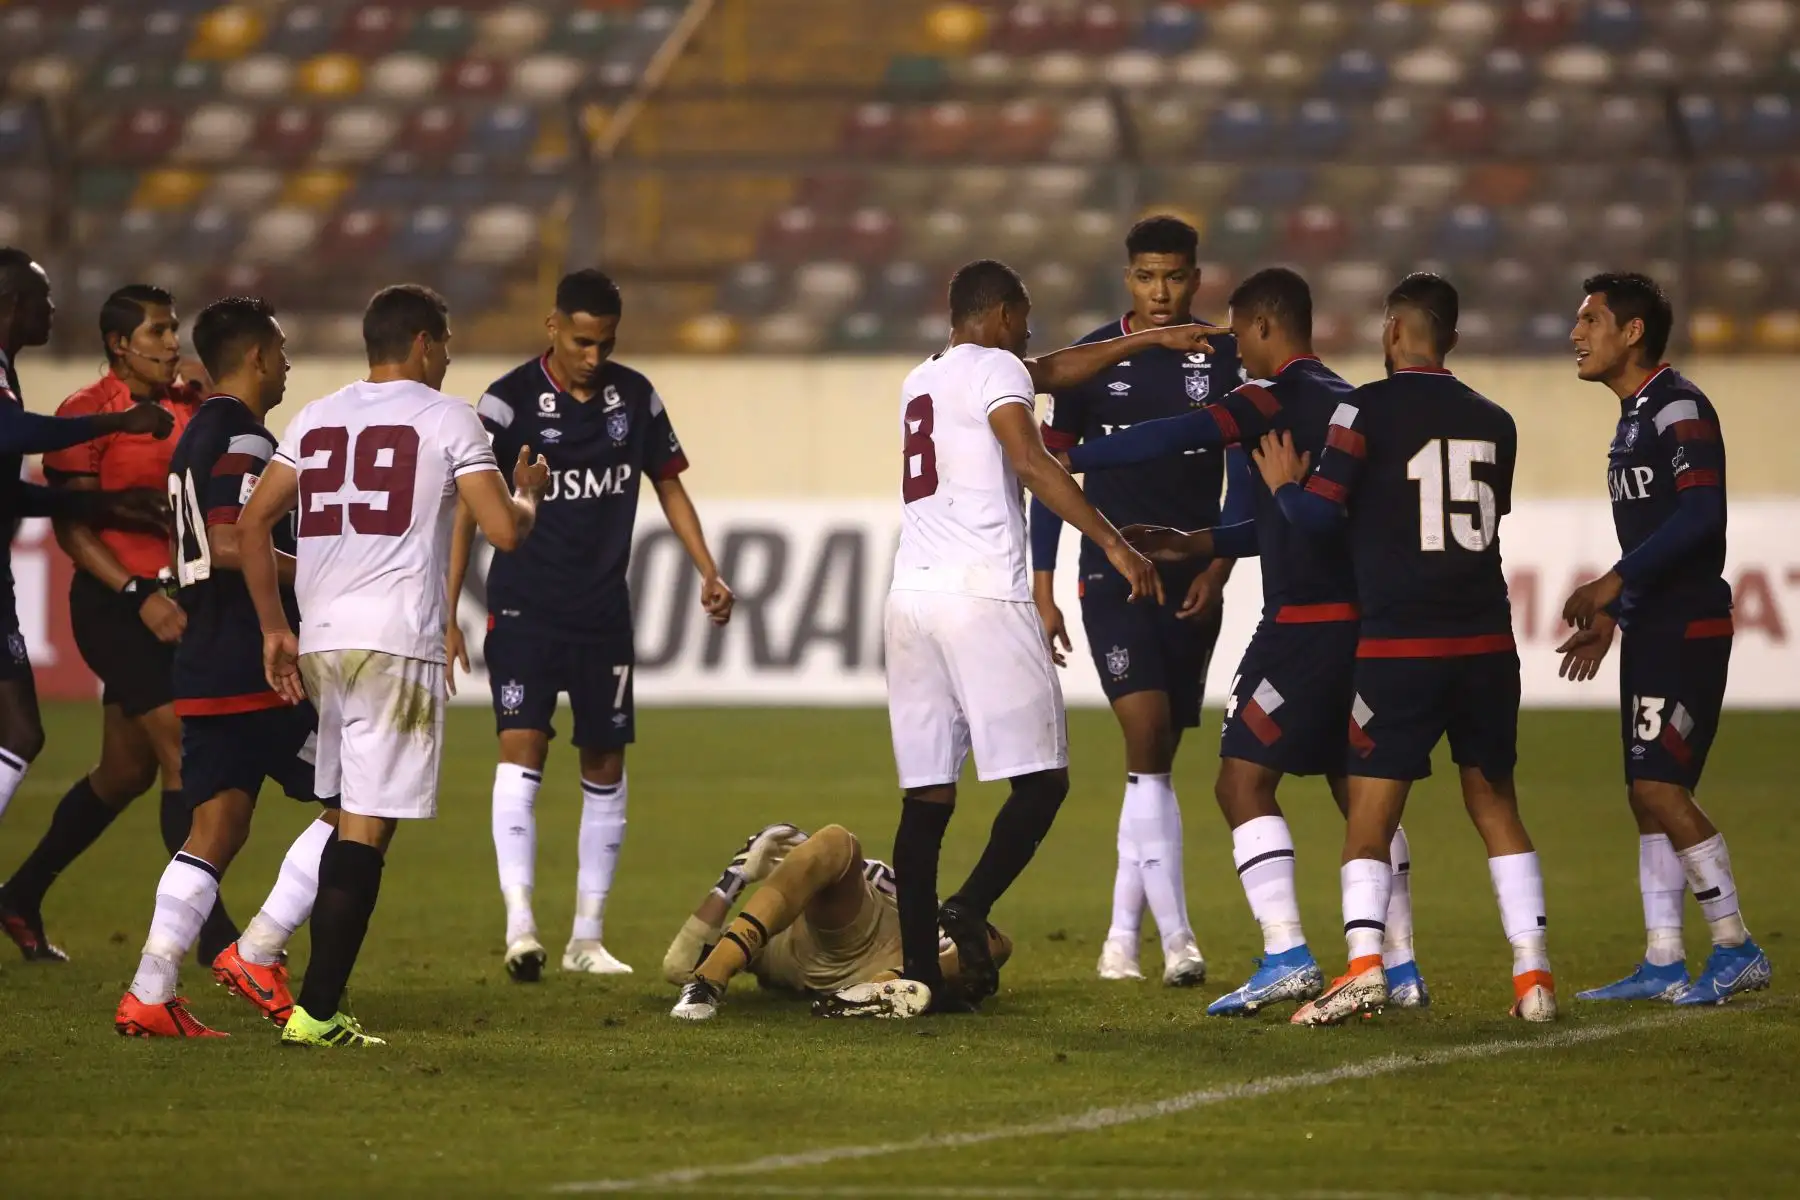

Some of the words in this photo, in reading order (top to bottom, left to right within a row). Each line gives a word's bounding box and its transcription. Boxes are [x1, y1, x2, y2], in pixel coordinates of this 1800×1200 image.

[538, 392, 556, 412] G
[902, 393, 939, 505] 8
[299, 425, 420, 538] 29
[1406, 438, 1496, 552] 15
[612, 665, 630, 709] 7
